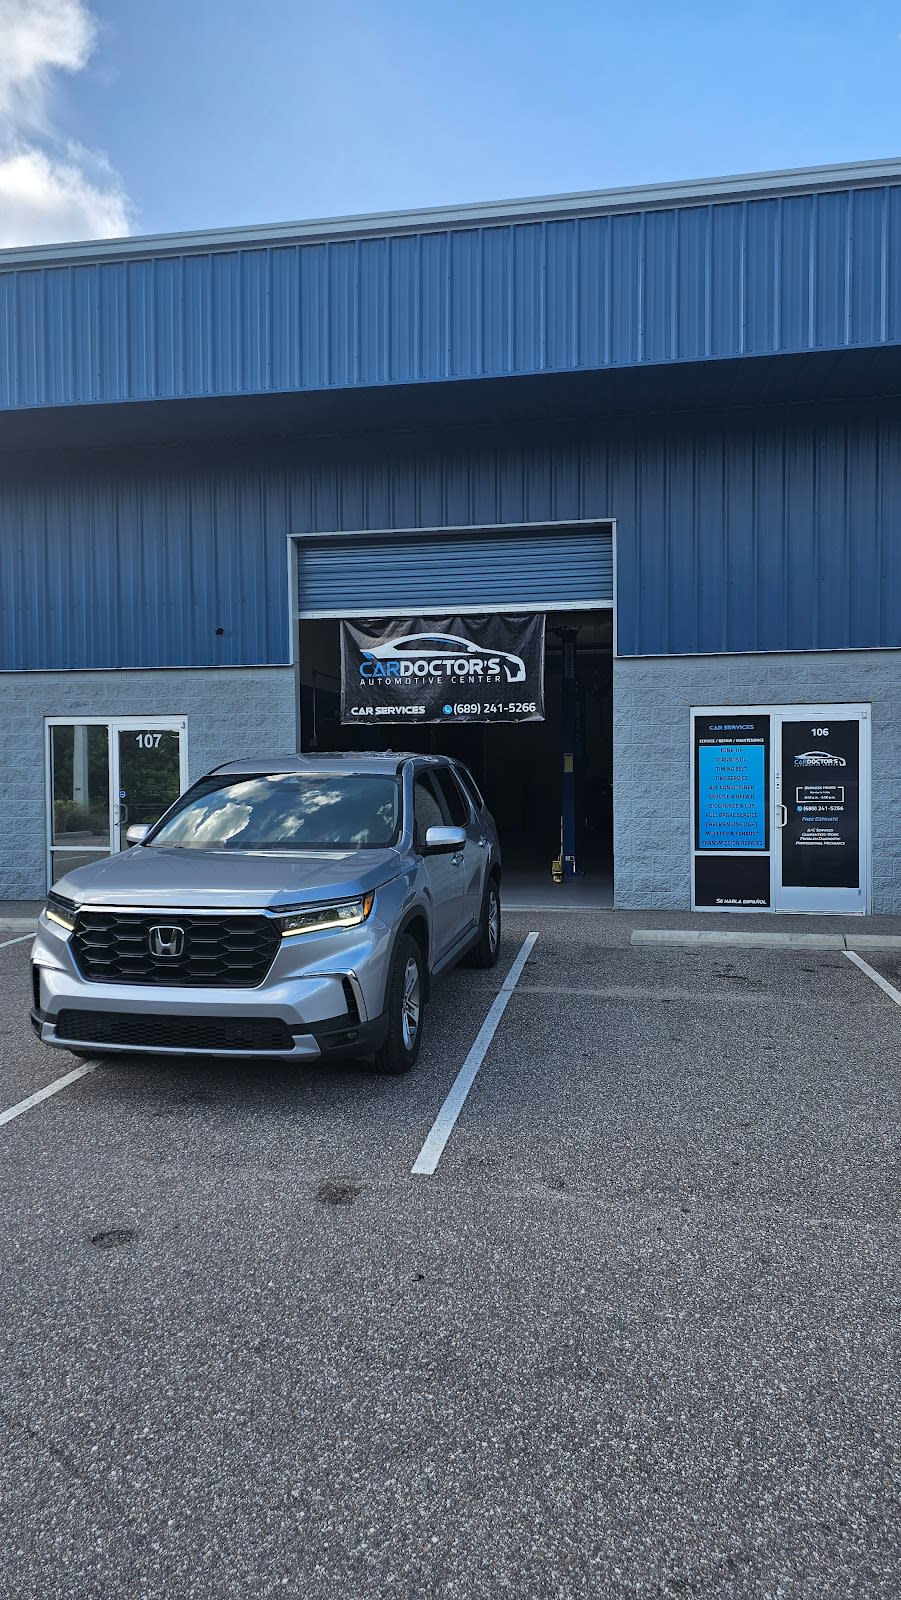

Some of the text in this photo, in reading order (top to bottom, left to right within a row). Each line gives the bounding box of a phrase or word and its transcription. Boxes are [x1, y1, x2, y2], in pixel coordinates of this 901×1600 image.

[359, 658, 501, 678] CARDOCTOR'S
[359, 675, 501, 686] AUTOMOTIVE CENTER
[351, 705, 426, 716] CAR SERVICES
[453, 702, 536, 715] (689) 241-5266
[811, 728, 829, 737] 106
[136, 733, 162, 748] 107
